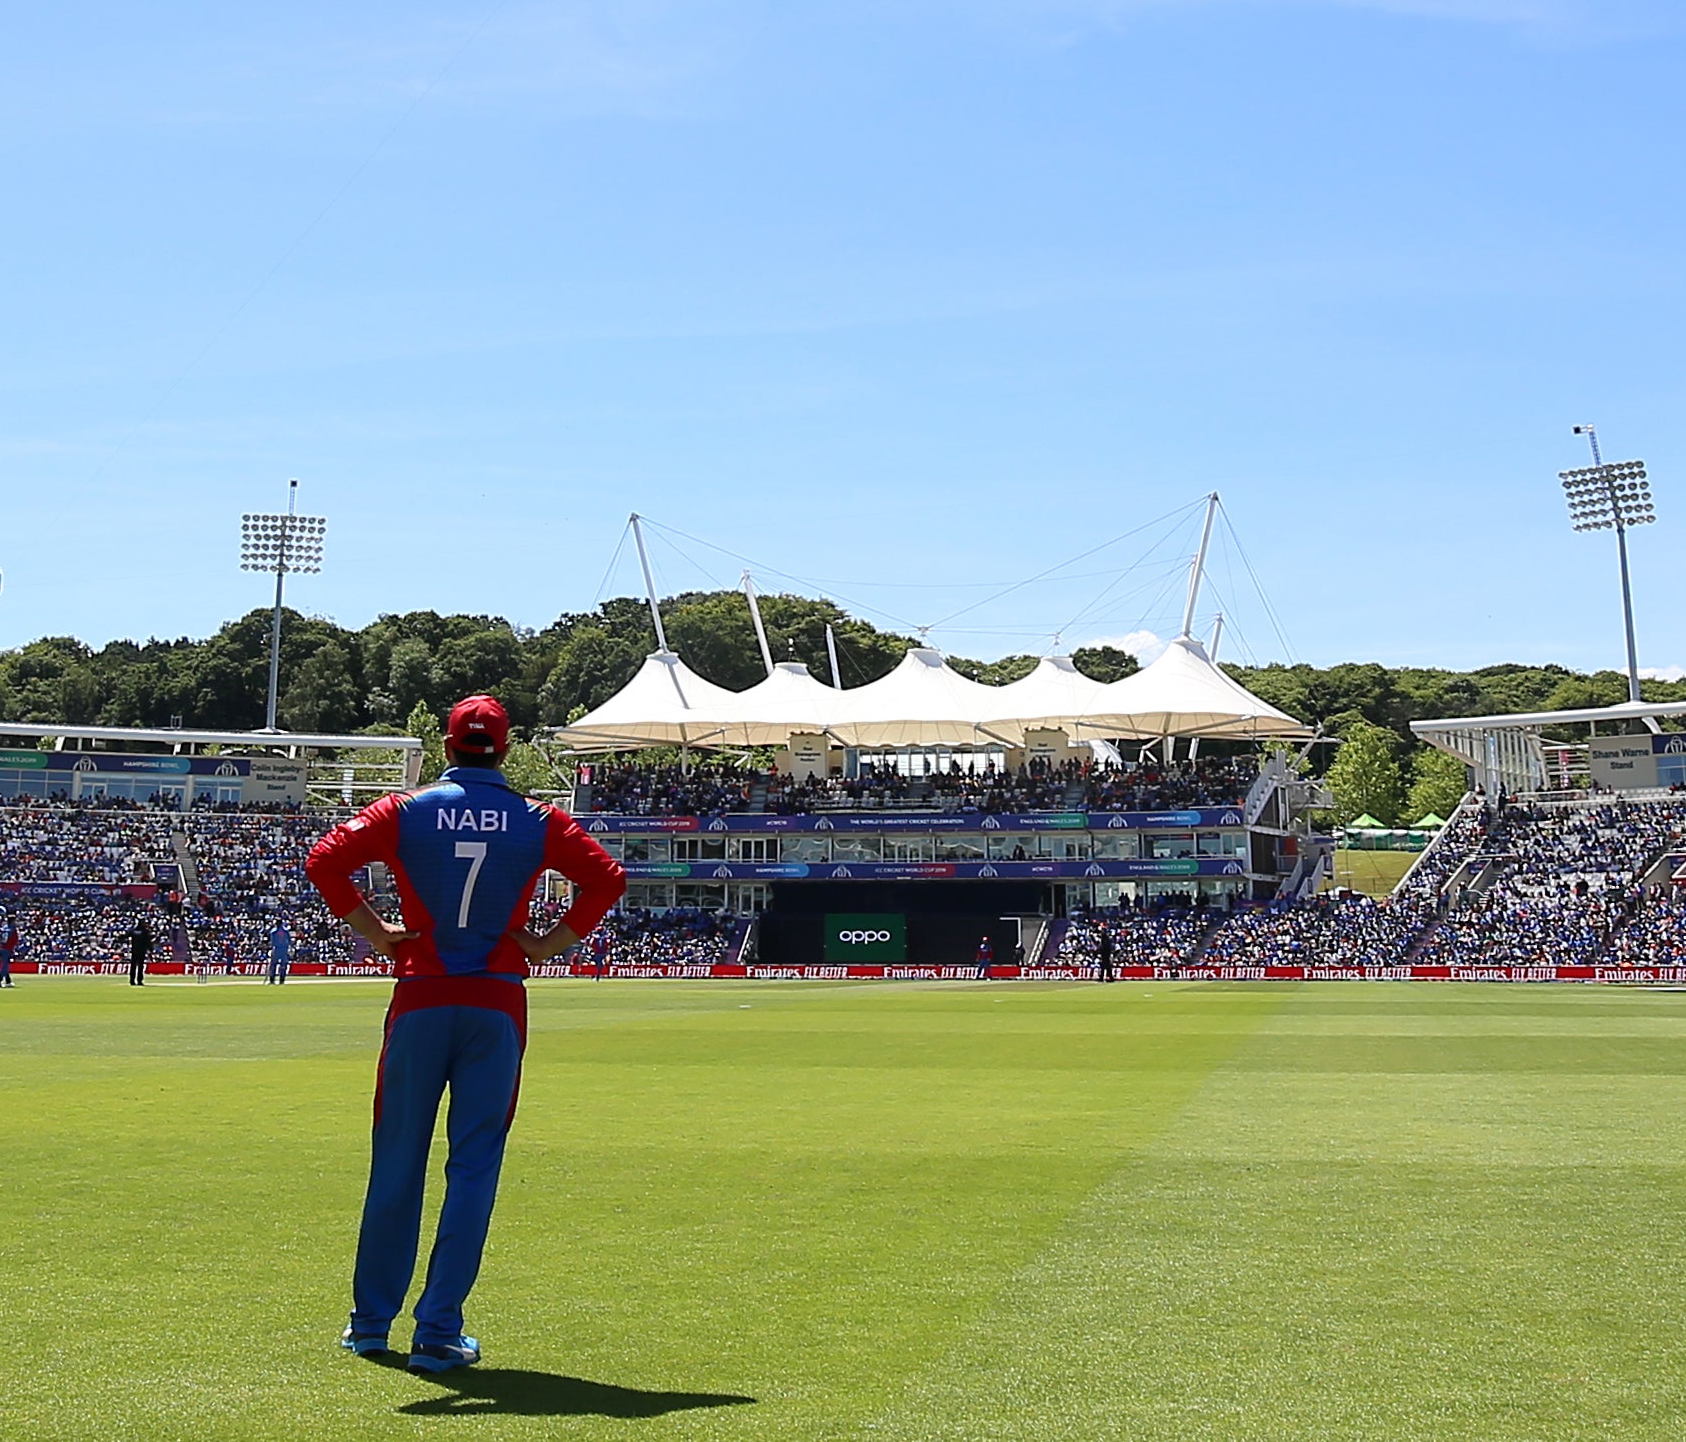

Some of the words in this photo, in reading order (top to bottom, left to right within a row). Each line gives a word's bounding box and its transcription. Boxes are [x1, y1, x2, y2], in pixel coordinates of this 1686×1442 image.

[1592, 749, 1620, 759] Shane
[1621, 747, 1650, 757] Warne
[1610, 761, 1633, 770] Stand
[436, 809, 507, 832] NABI
[455, 841, 487, 928] 7
[839, 930, 891, 945] oppo
[38, 962, 95, 974] Emirates
[327, 963, 381, 975] Emirates
[609, 964, 663, 977] Emirates
[683, 964, 712, 977] BETTER
[746, 965, 800, 978] Emirates
[819, 965, 848, 978] BETTER
[884, 966, 937, 978] Emirates
[1021, 967, 1074, 979] Emirates
[1304, 966, 1360, 979] Emirates
[1381, 966, 1412, 979] BETTER
[1451, 967, 1509, 979] Emirates
[1526, 967, 1557, 979] BETTER
[1595, 967, 1654, 980] Emirates
